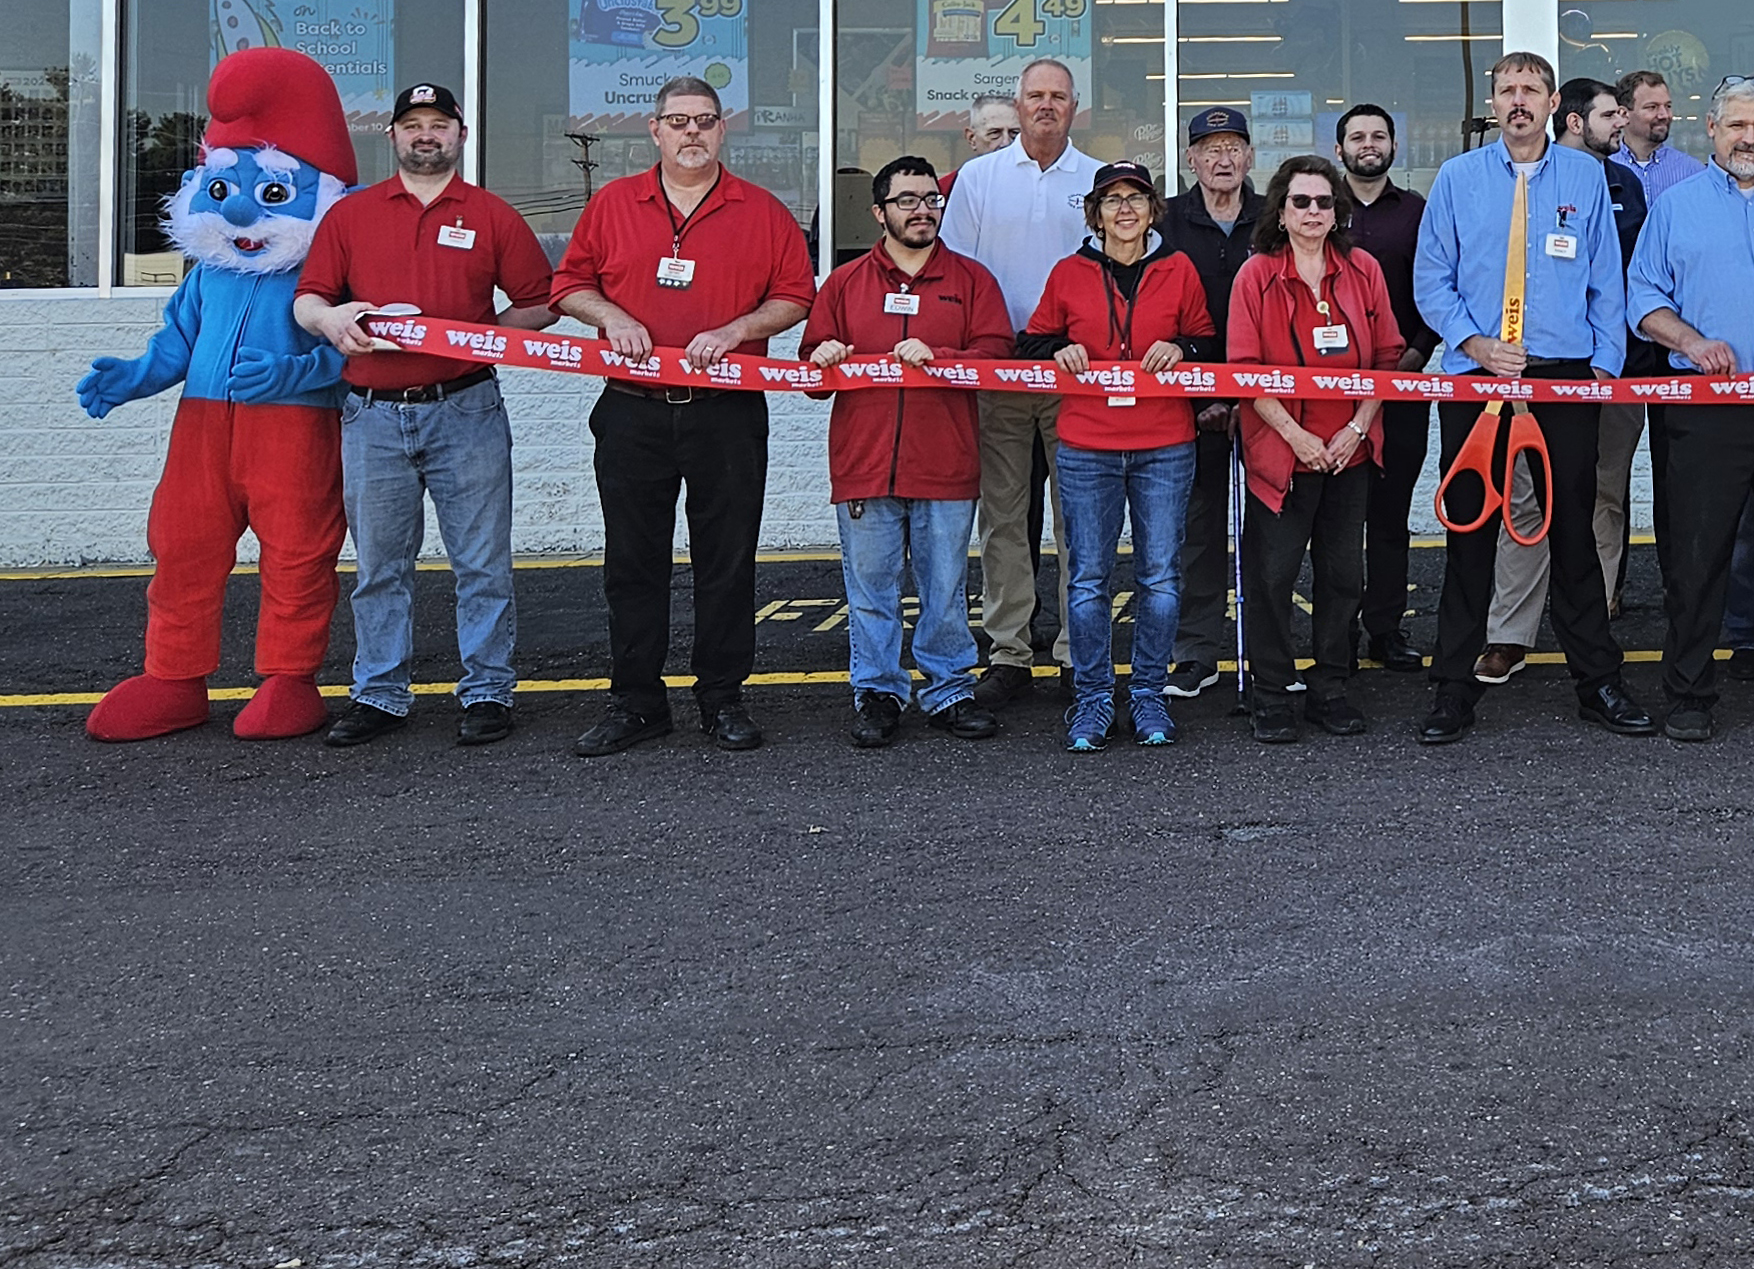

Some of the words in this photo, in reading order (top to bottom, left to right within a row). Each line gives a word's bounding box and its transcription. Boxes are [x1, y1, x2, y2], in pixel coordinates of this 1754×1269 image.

[294, 21, 342, 36] Back
[347, 22, 367, 36] to
[294, 40, 358, 56] School
[322, 60, 388, 75] entials
[974, 72, 1019, 88] Sargen
[927, 89, 970, 102] Snack
[369, 318, 426, 339] weis
[446, 330, 506, 351] weis
[524, 340, 582, 361] weis
[759, 366, 822, 383] weis
[840, 360, 902, 377] weis
[923, 364, 979, 382] weis
[995, 366, 1056, 384] weis
[1075, 366, 1135, 385] weis
[1155, 367, 1215, 386] weis
[1233, 370, 1295, 388] weis
[1312, 374, 1374, 392] weis
[1392, 376, 1454, 392] weis
[1471, 381, 1533, 396] weis
[1551, 383, 1612, 396] weis
[1631, 381, 1692, 396] weis
